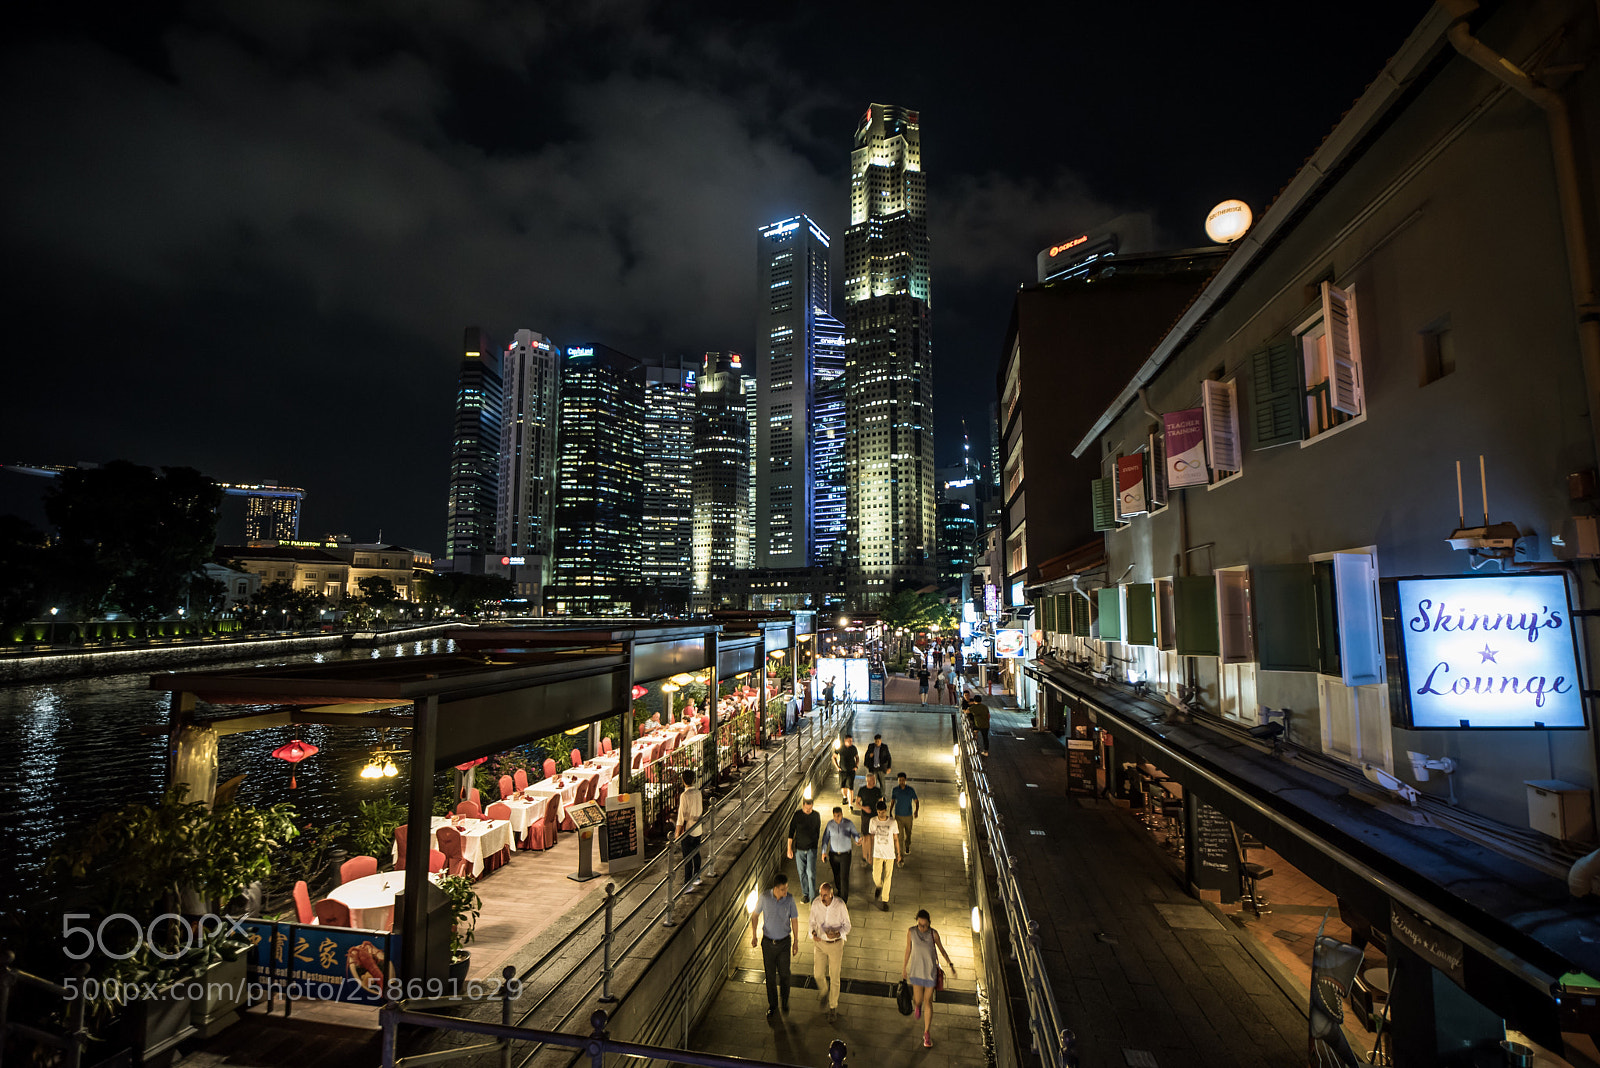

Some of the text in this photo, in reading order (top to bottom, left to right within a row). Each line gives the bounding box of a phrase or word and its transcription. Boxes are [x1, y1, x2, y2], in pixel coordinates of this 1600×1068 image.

[1058, 235, 1088, 252] OCBC Bank
[1167, 420, 1201, 430] TEACHER
[1167, 427, 1201, 437] TRAINING
[1409, 599, 1563, 643] Skinny's
[1416, 661, 1573, 708] Lounge
[1429, 942, 1462, 970] Lounge
[301, 970, 343, 985] Restaurant
